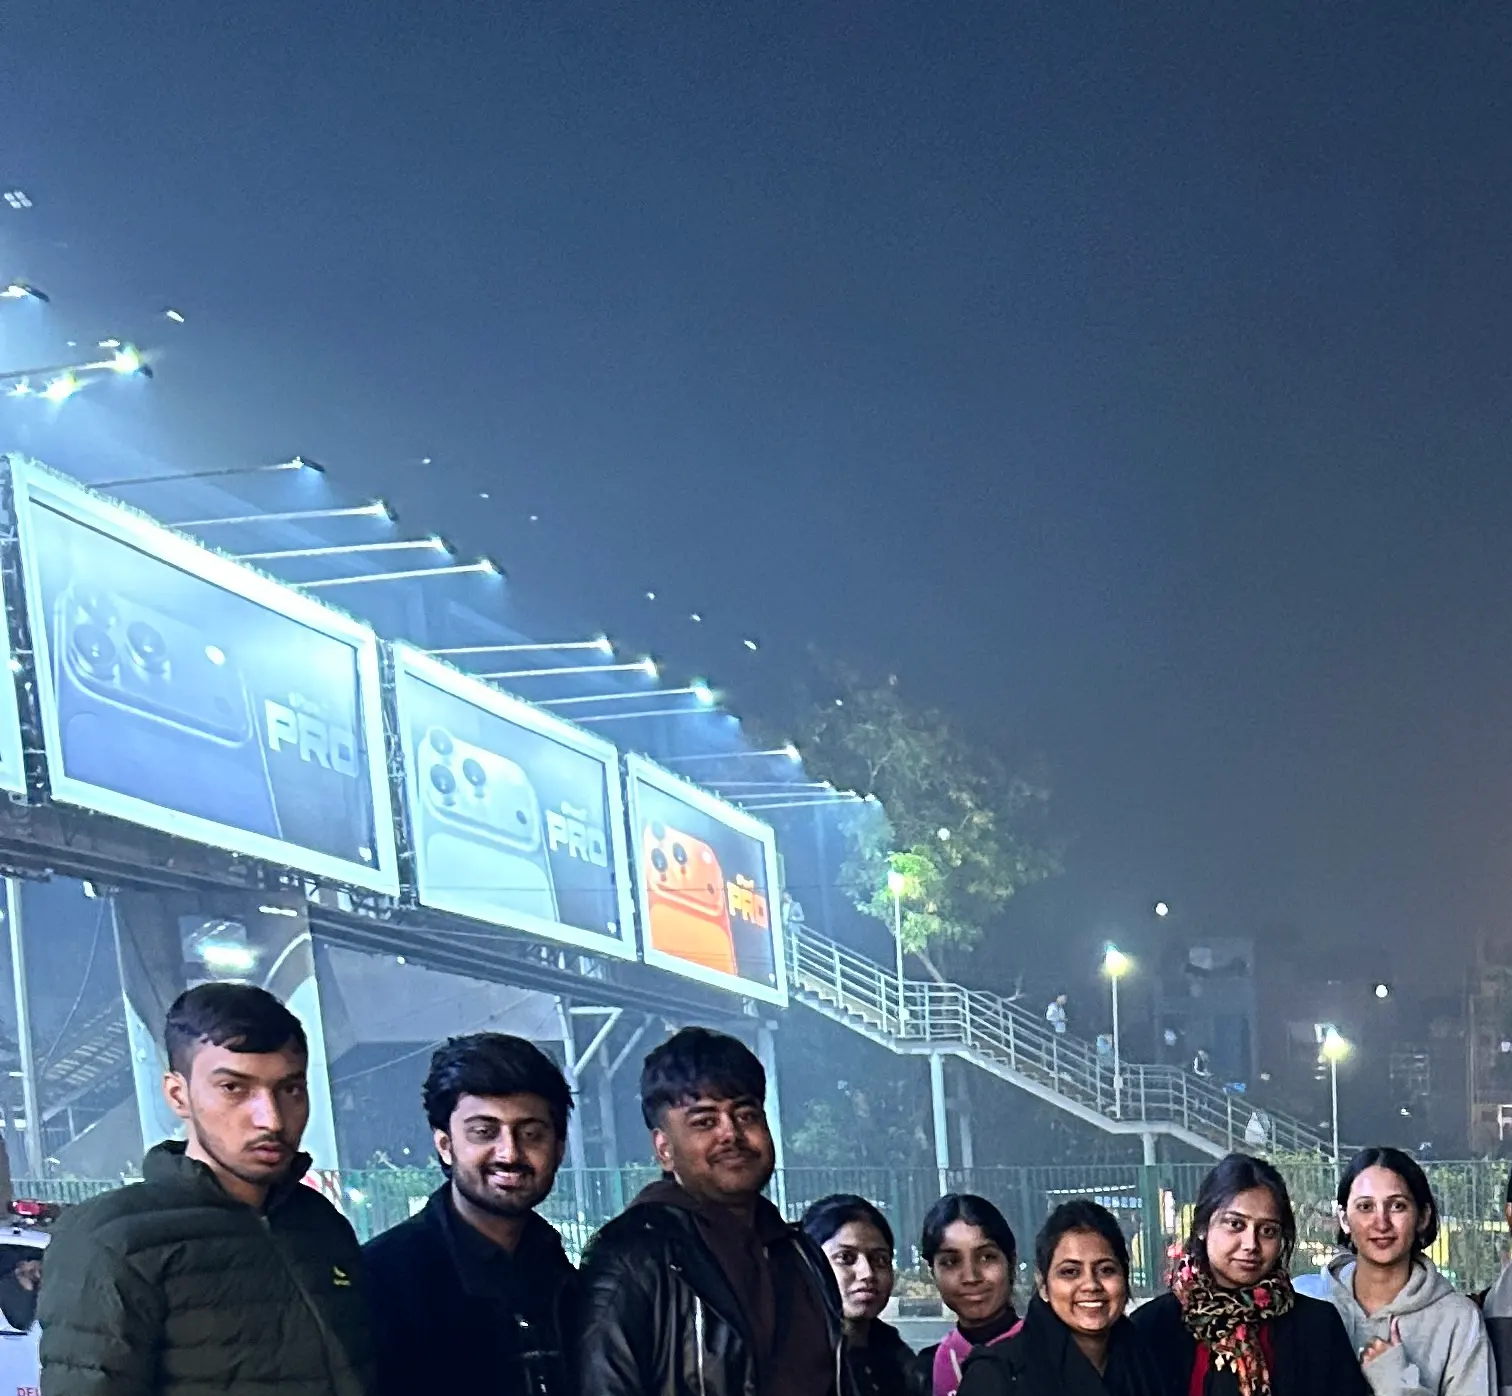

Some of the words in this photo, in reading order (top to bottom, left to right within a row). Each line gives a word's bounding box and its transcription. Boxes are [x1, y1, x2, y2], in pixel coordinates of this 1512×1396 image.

[264, 698, 359, 778] PRO
[545, 809, 608, 868] PRO
[727, 881, 769, 929] PRO
